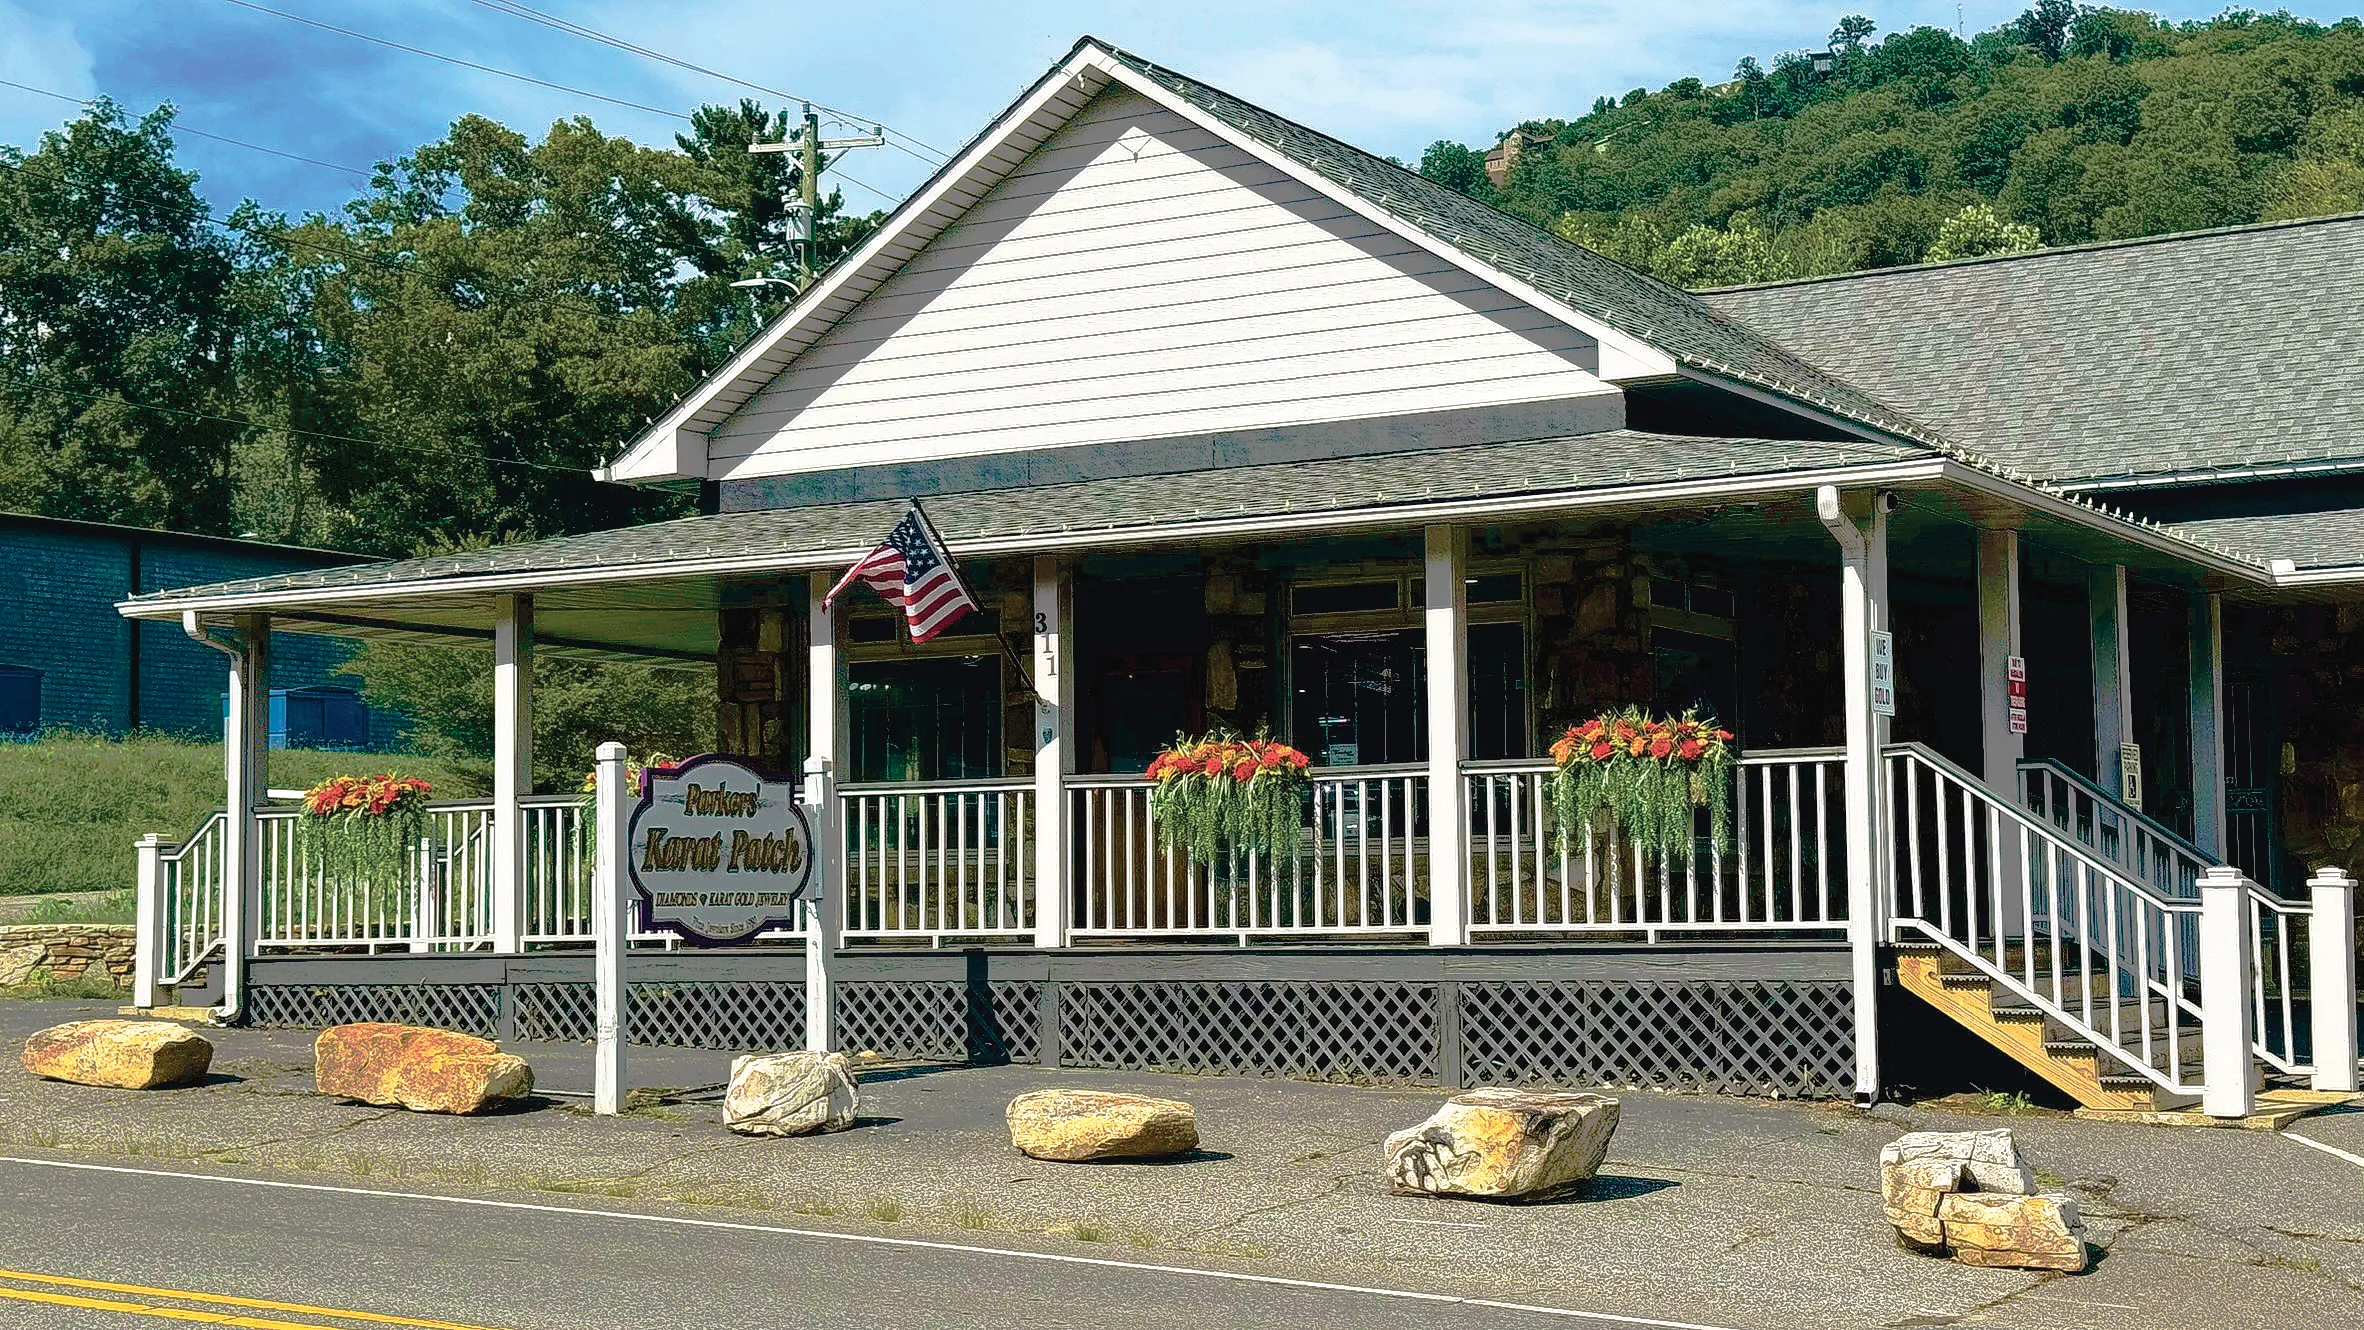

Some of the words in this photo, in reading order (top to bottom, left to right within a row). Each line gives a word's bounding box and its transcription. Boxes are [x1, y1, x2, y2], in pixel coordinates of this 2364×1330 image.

[1035, 612, 1057, 676] 311
[1875, 637, 1887, 656] WE
[1875, 662, 1888, 681] BUY
[1874, 687, 1890, 705] GOLD
[641, 827, 722, 873] Karat
[726, 827, 803, 874] Patch
[655, 891, 698, 907] DIAMONDS
[708, 891, 735, 907] KARAT
[734, 891, 755, 907] GOLD
